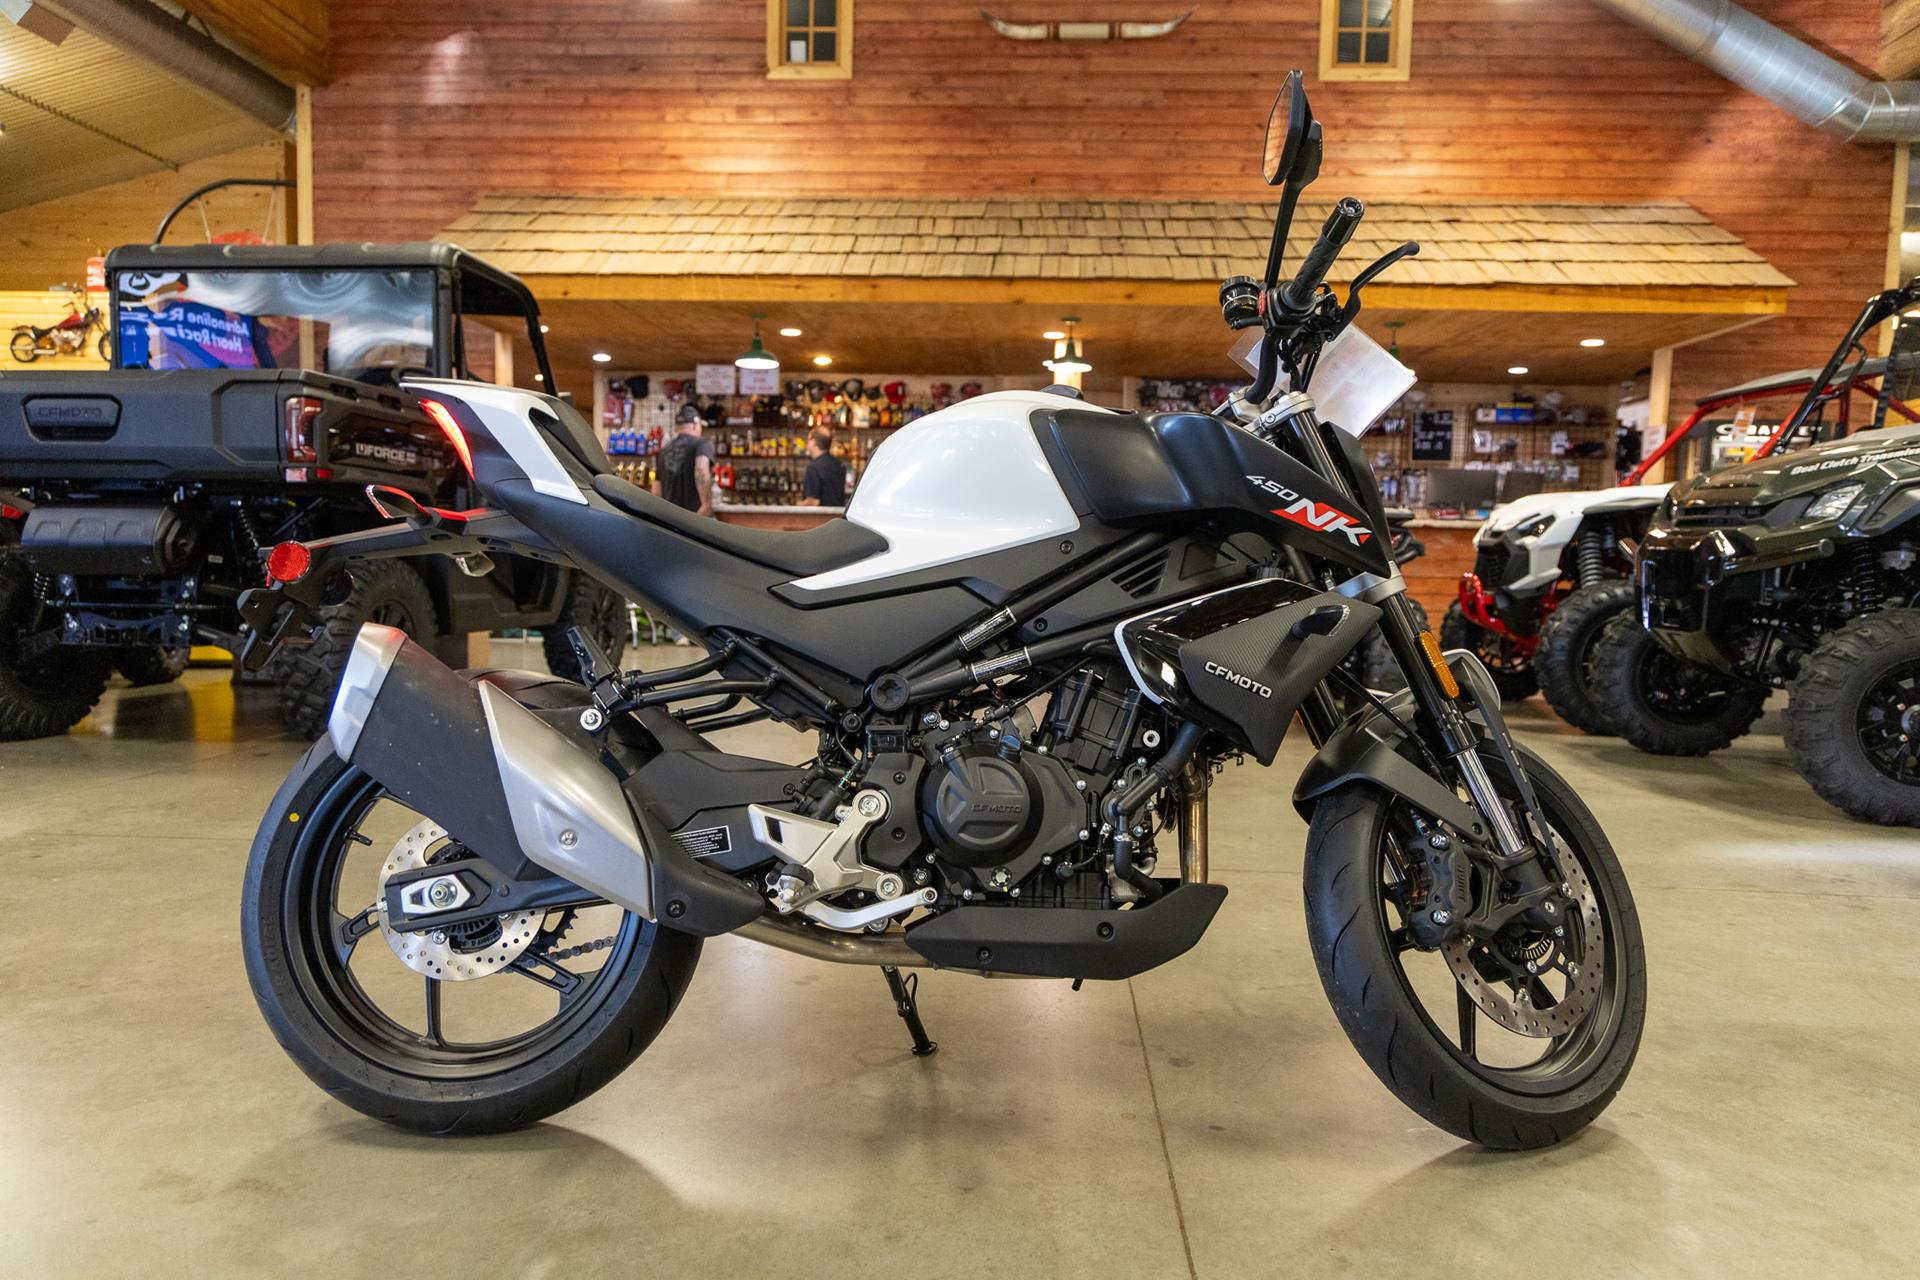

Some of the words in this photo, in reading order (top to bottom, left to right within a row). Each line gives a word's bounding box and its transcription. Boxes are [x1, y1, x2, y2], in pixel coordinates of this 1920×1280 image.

[37, 407, 102, 417] CFMOTO
[1790, 463, 1820, 475] Dual
[1820, 456, 1860, 470] Clutch
[1245, 475, 1299, 501] 450
[1284, 497, 1372, 547] NK
[1204, 661, 1273, 699] CFMOTO
